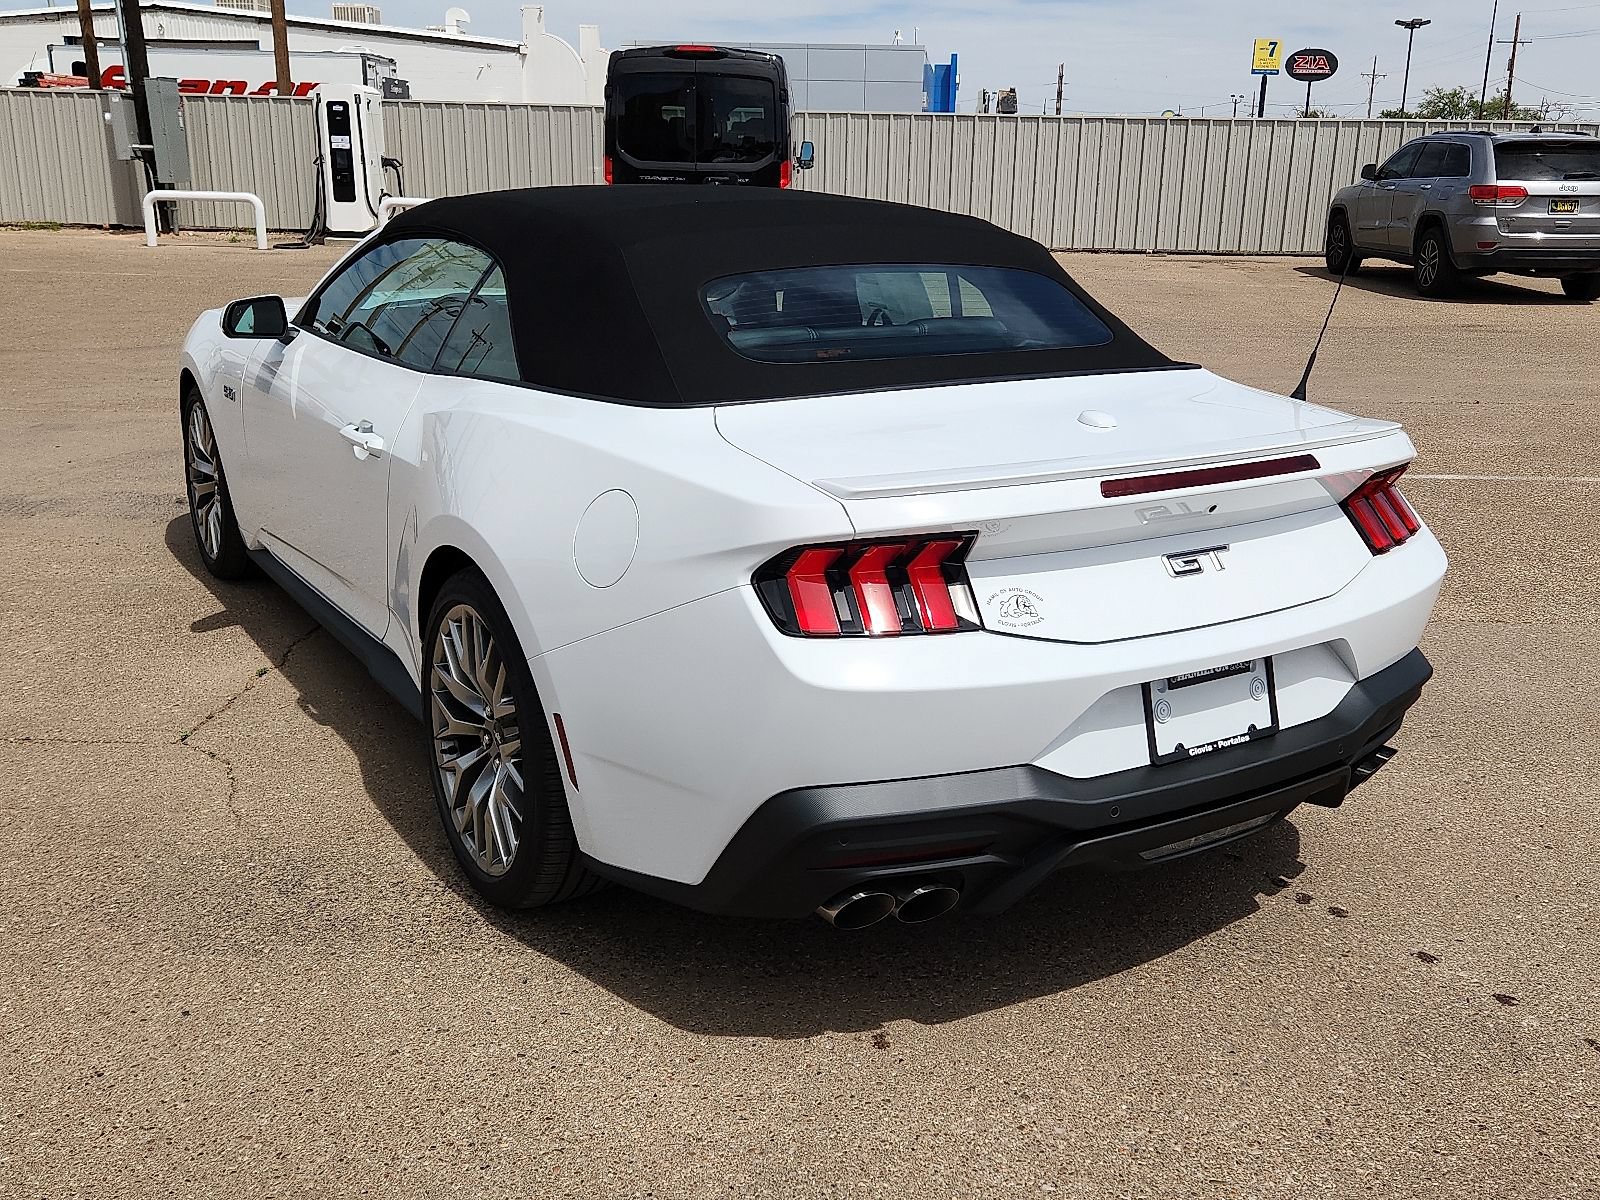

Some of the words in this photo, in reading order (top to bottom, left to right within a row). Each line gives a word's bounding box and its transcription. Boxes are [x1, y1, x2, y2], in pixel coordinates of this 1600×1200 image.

[1268, 41, 1278, 57] 7
[1293, 55, 1330, 70] ZIA
[1559, 184, 1578, 192] Jeep
[1161, 544, 1230, 578] GT
[1024, 588, 1044, 602] GROUP
[1188, 744, 1213, 757] Clovis
[1217, 734, 1251, 749] Portales
